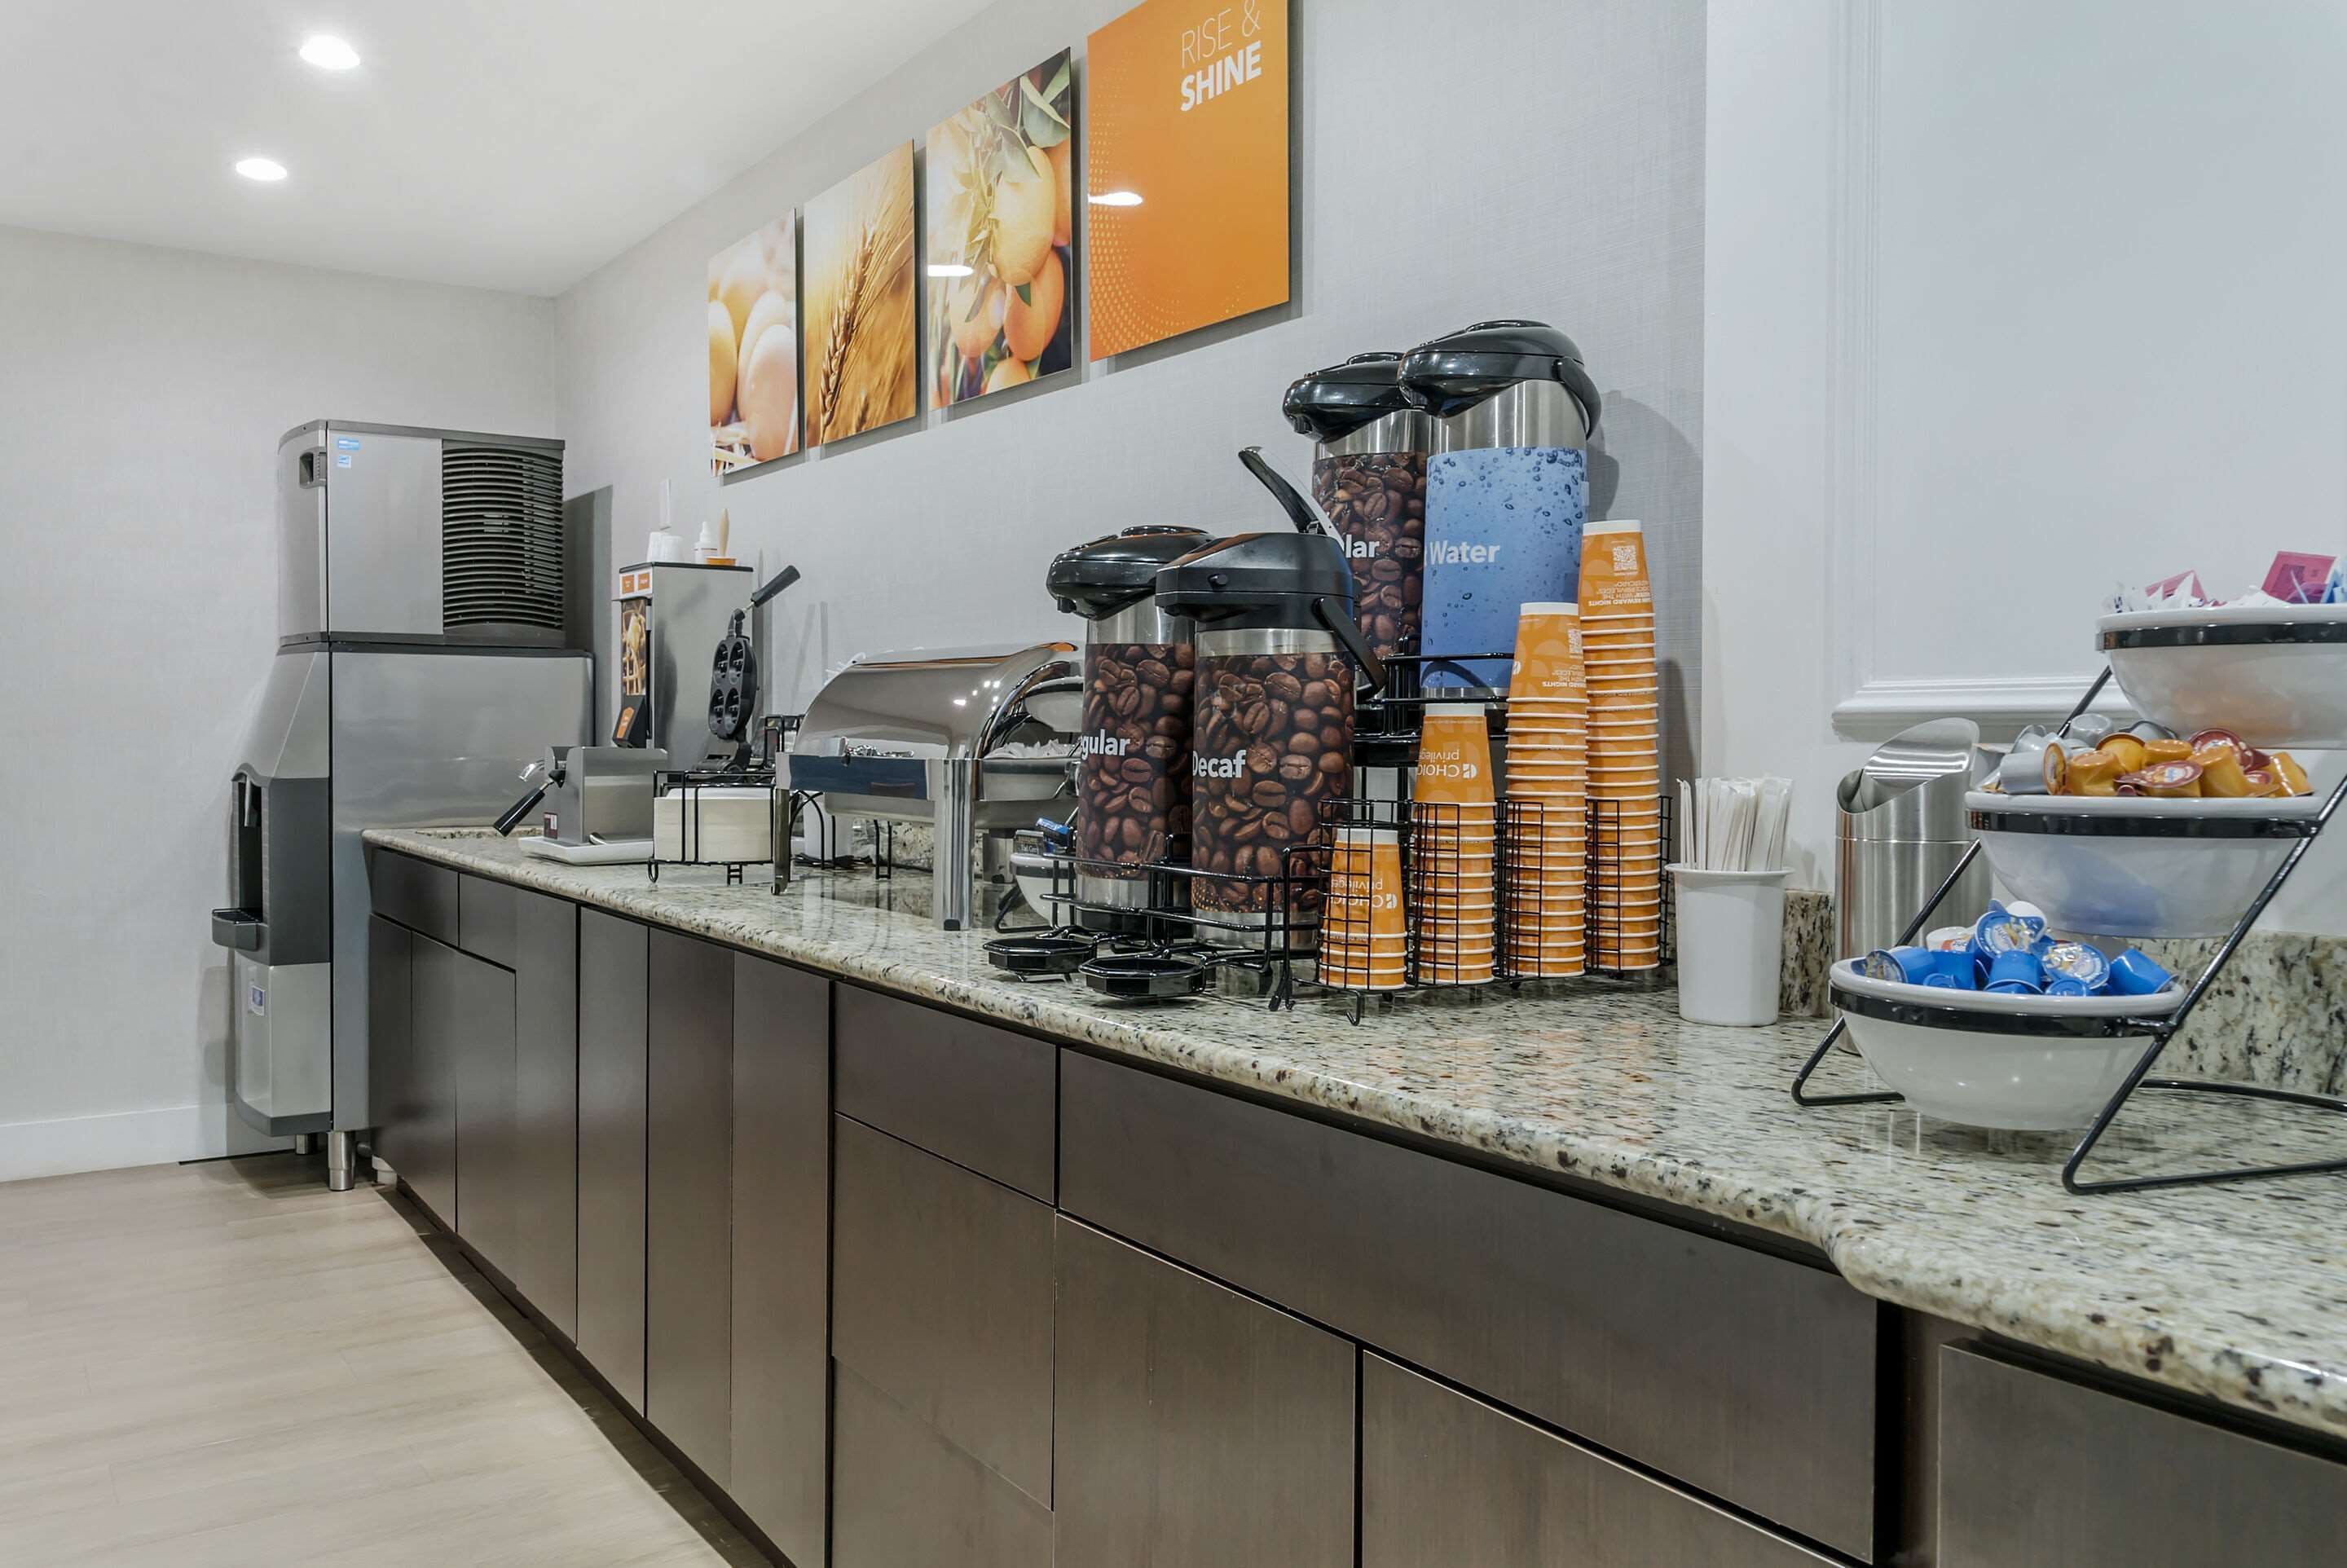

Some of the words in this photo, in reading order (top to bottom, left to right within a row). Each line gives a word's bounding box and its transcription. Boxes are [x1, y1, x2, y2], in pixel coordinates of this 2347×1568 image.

[1181, 8, 1233, 68] RISE
[1241, 0, 1262, 37] &
[1181, 40, 1262, 112] SHINE
[1429, 540, 1500, 566] Water
[1081, 729, 1131, 760] gular
[1419, 748, 1460, 763] privileg
[1193, 749, 1247, 778] Decaf
[1418, 764, 1460, 777] CHOIC
[1331, 893, 1384, 908] CHOIC
